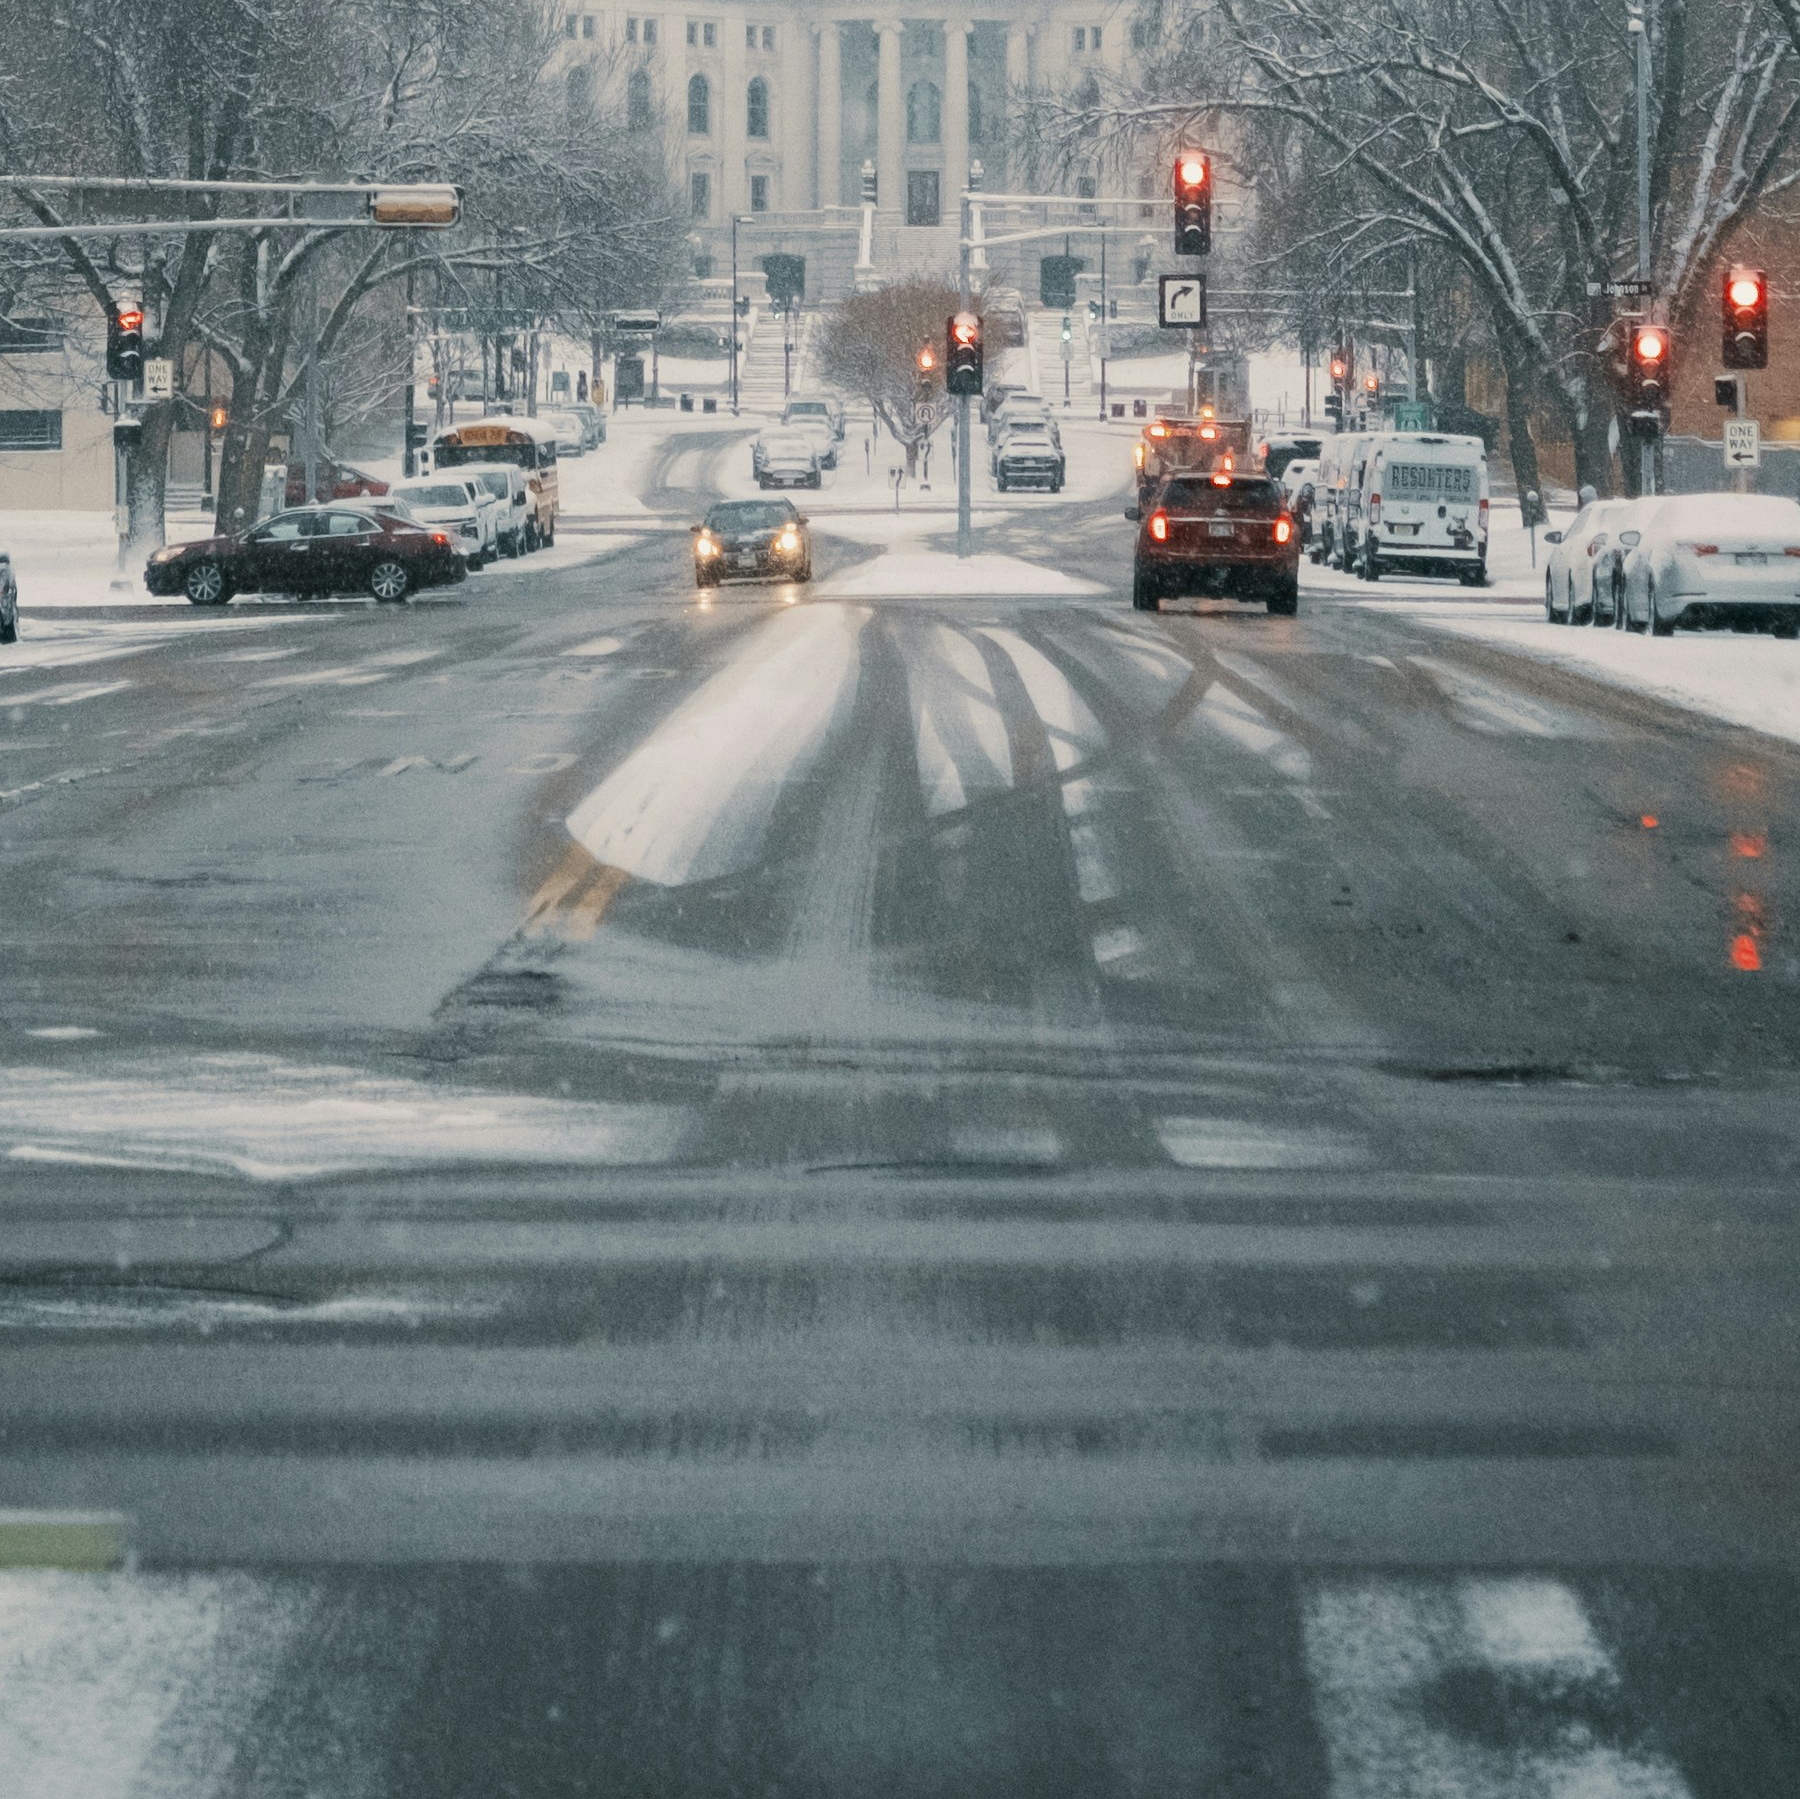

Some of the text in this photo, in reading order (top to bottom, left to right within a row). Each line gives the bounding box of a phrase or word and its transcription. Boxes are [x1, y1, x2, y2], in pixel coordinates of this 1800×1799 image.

[1602, 282, 1639, 296] Jonson
[1171, 312, 1193, 320] ONLY
[148, 364, 168, 374] ONE
[148, 375, 168, 384] WAY
[1730, 426, 1753, 437] ONE
[1729, 438, 1753, 449] WAY
